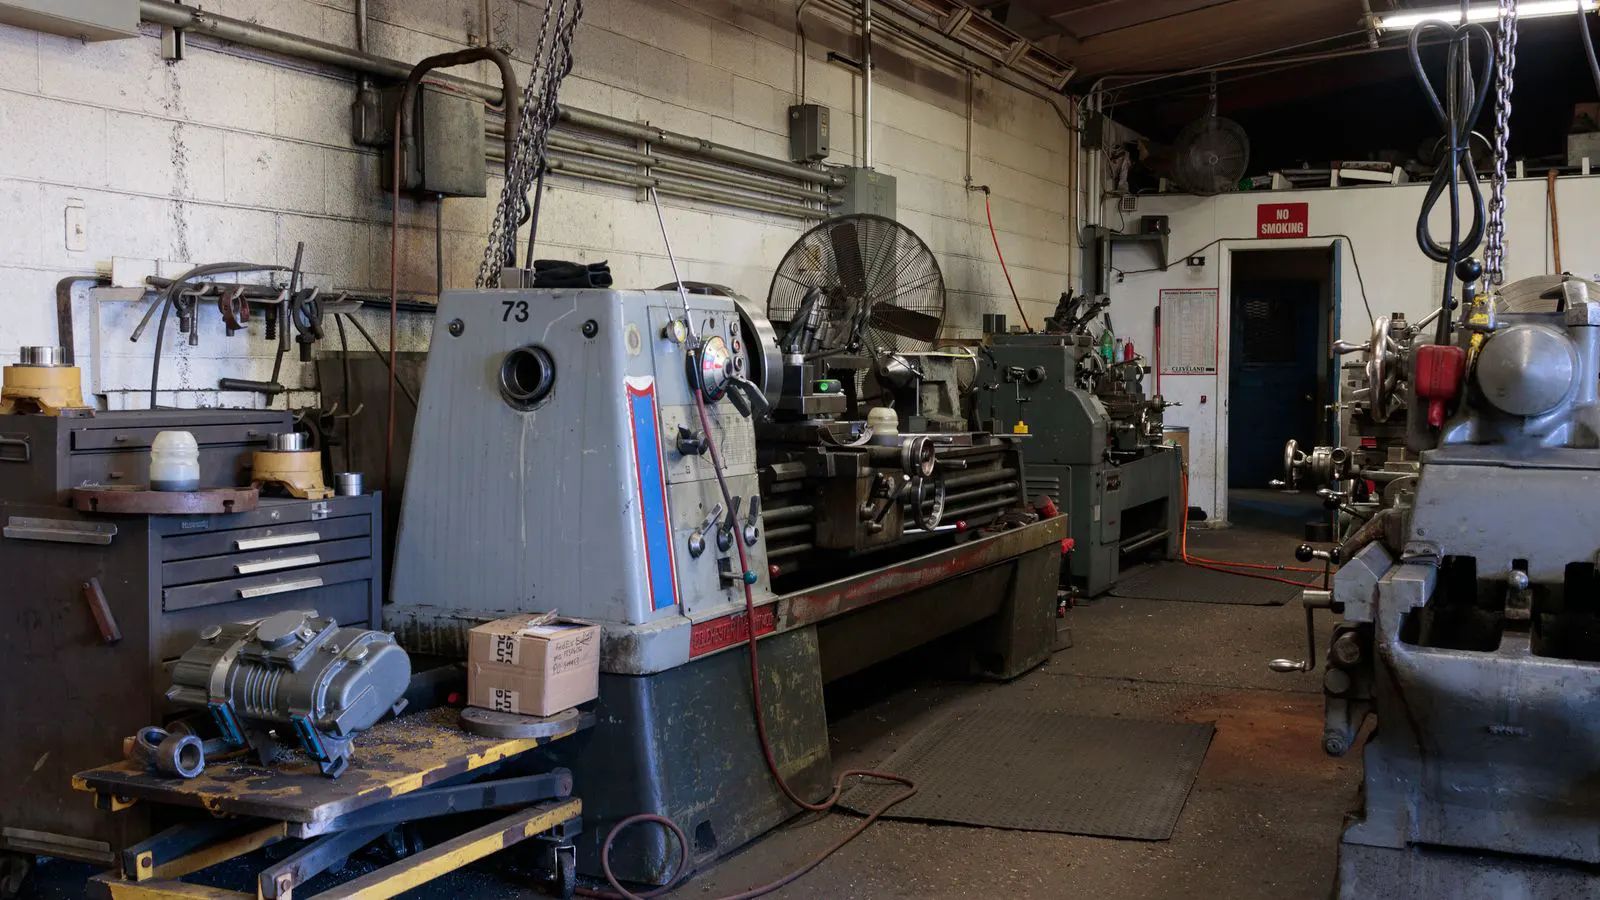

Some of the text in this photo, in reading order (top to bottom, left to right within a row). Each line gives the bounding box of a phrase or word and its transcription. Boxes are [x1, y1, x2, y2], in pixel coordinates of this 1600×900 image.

[1276, 209, 1289, 220] NO
[1261, 222, 1304, 234] SMOKING
[502, 300, 529, 323] 73
